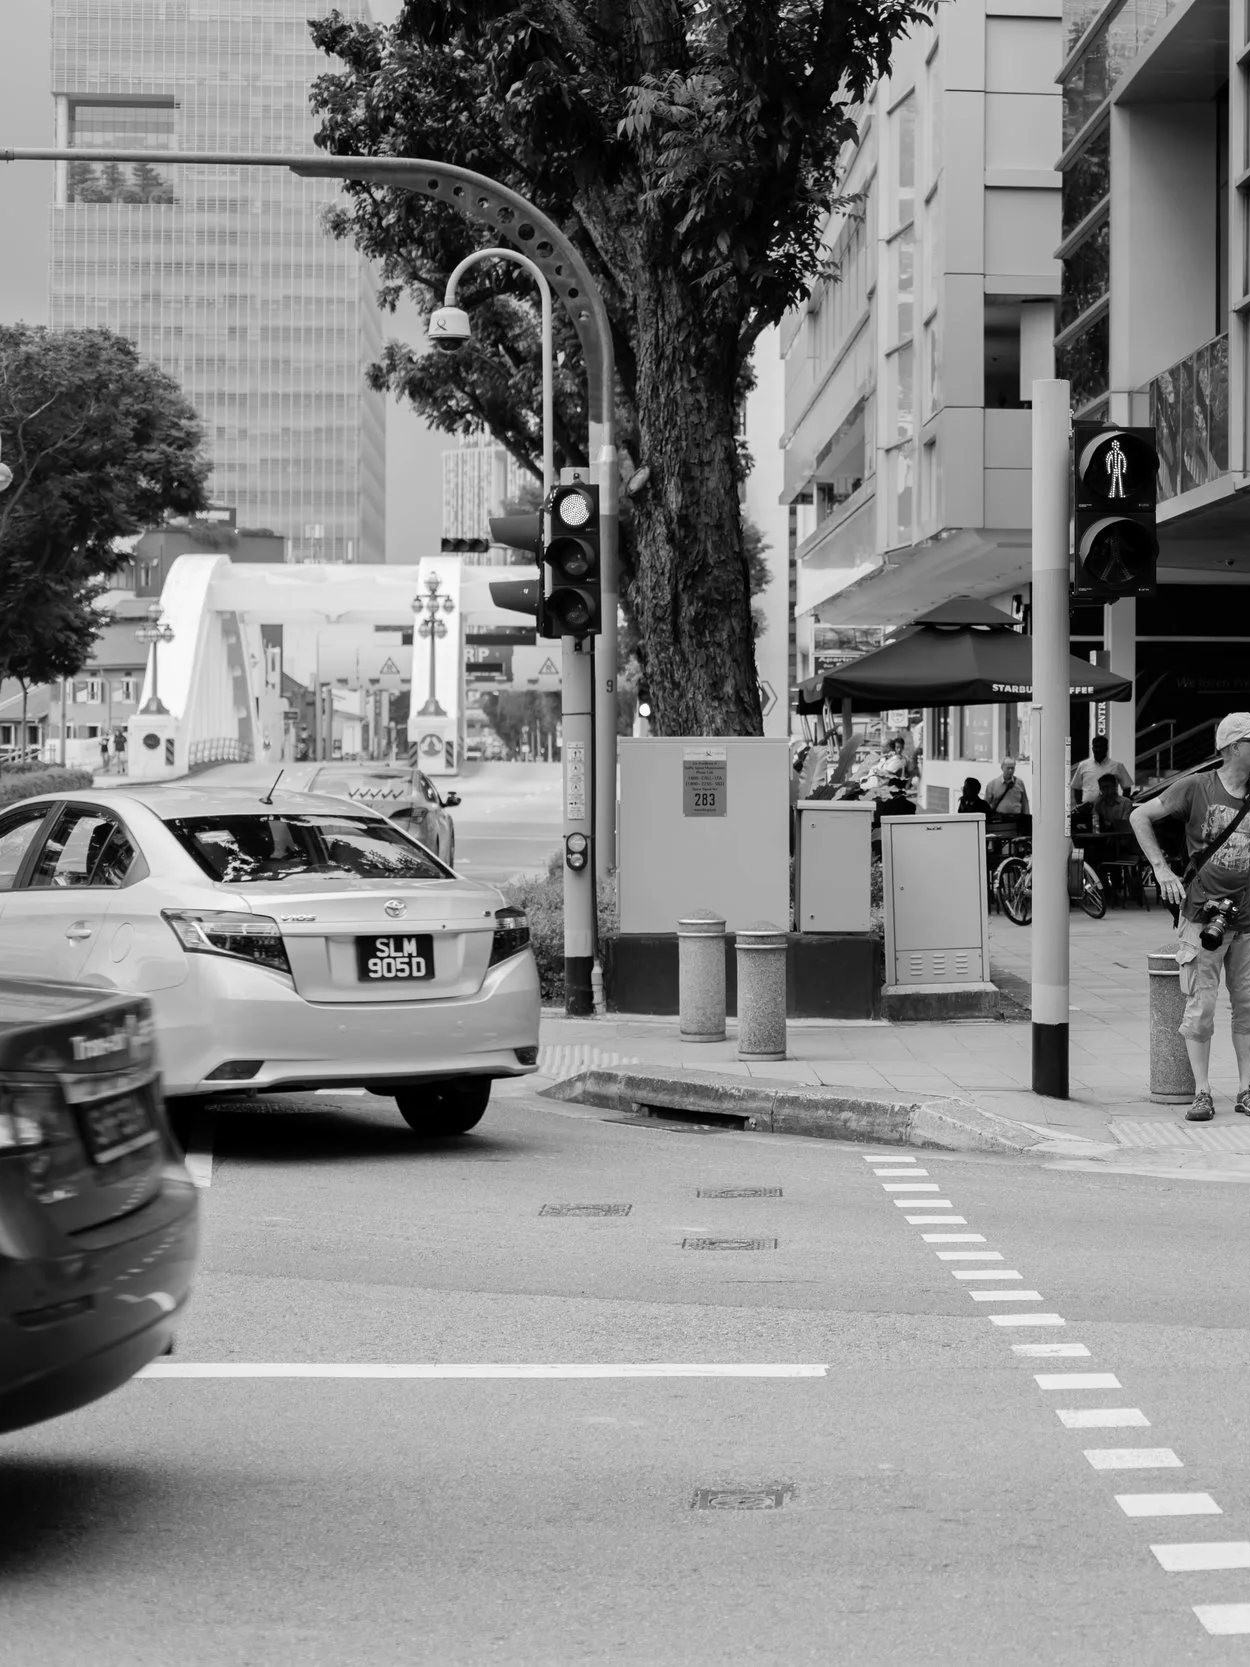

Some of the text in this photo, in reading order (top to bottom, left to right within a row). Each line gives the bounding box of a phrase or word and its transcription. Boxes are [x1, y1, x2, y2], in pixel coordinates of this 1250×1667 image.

[464, 648, 489, 662] RP
[606, 679, 613, 693] 9
[992, 683, 1094, 694] STARBU FFEE
[1097, 702, 1106, 736] CENTR
[694, 793, 715, 806] 283
[375, 938, 417, 957] SLM
[368, 957, 426, 978] 905D
